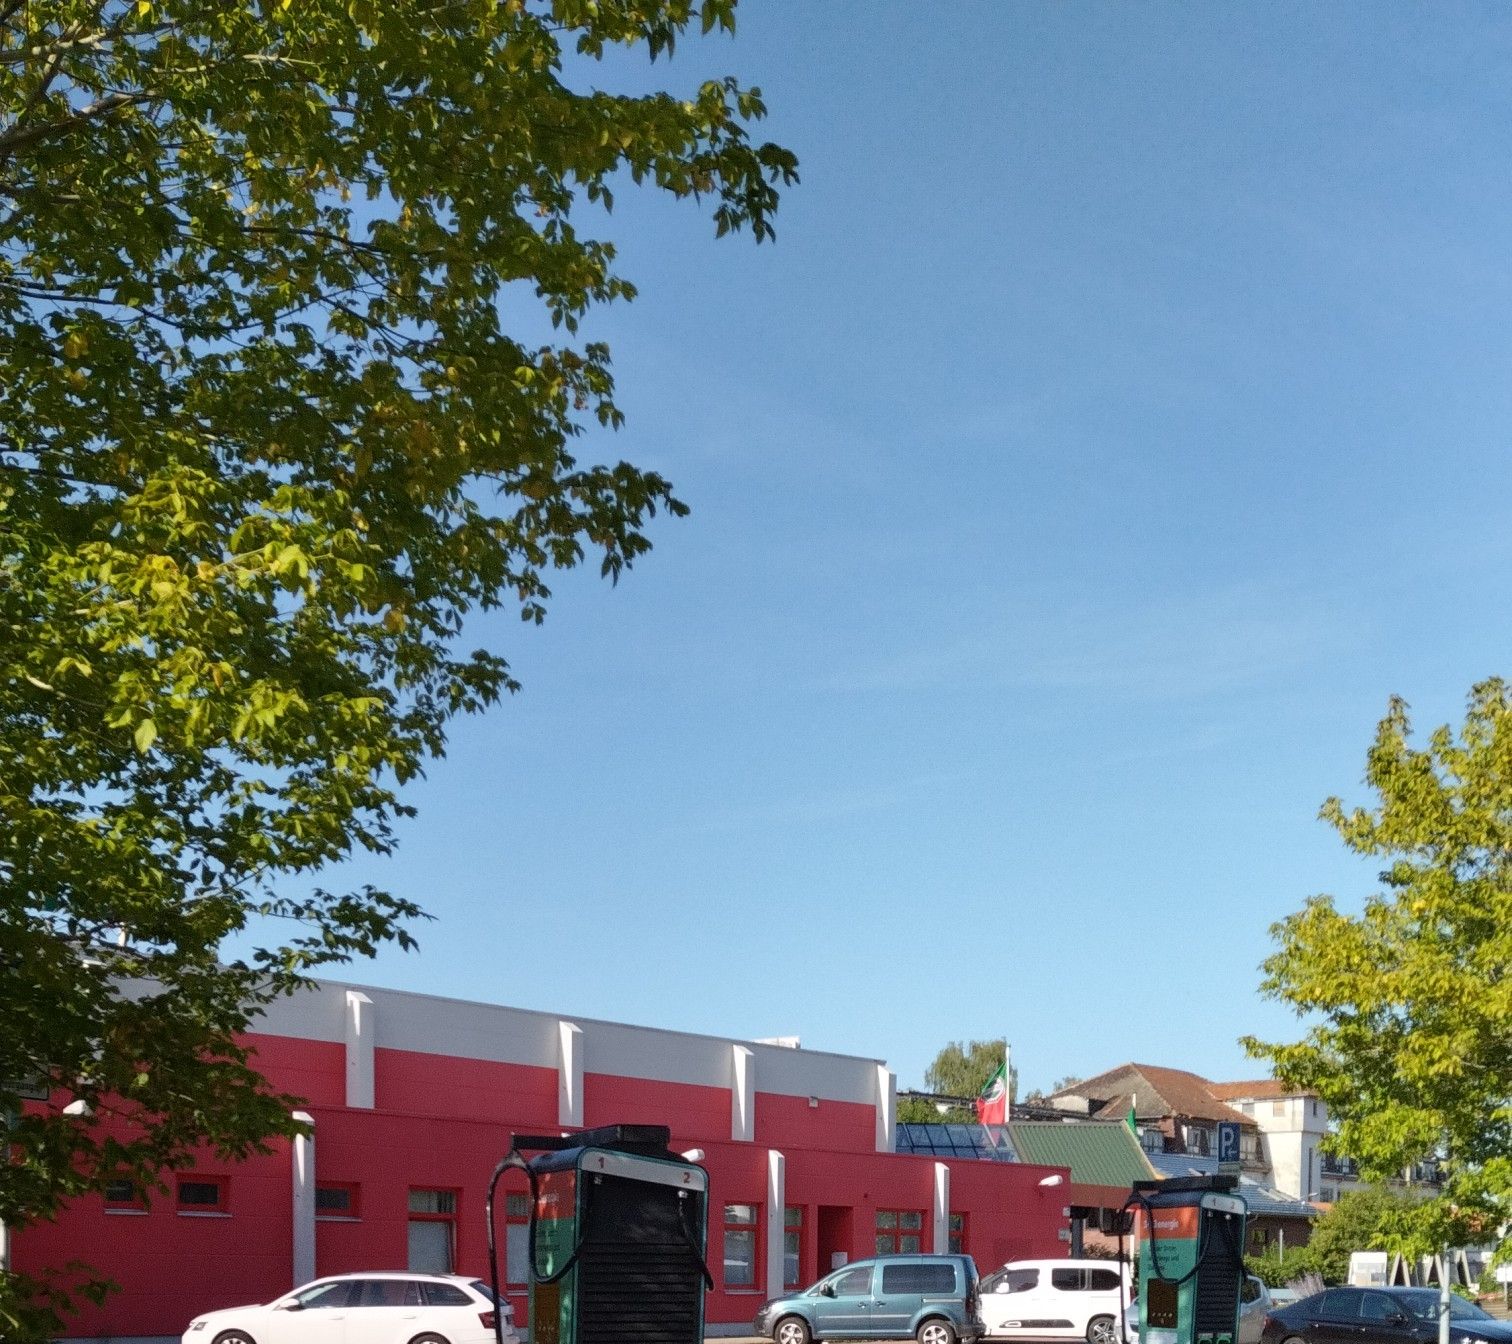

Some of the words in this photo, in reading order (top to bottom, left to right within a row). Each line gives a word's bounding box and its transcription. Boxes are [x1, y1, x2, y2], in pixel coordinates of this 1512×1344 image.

[1221, 1127, 1235, 1158] P
[597, 1156, 606, 1169] 1
[682, 1172, 692, 1184] 2
